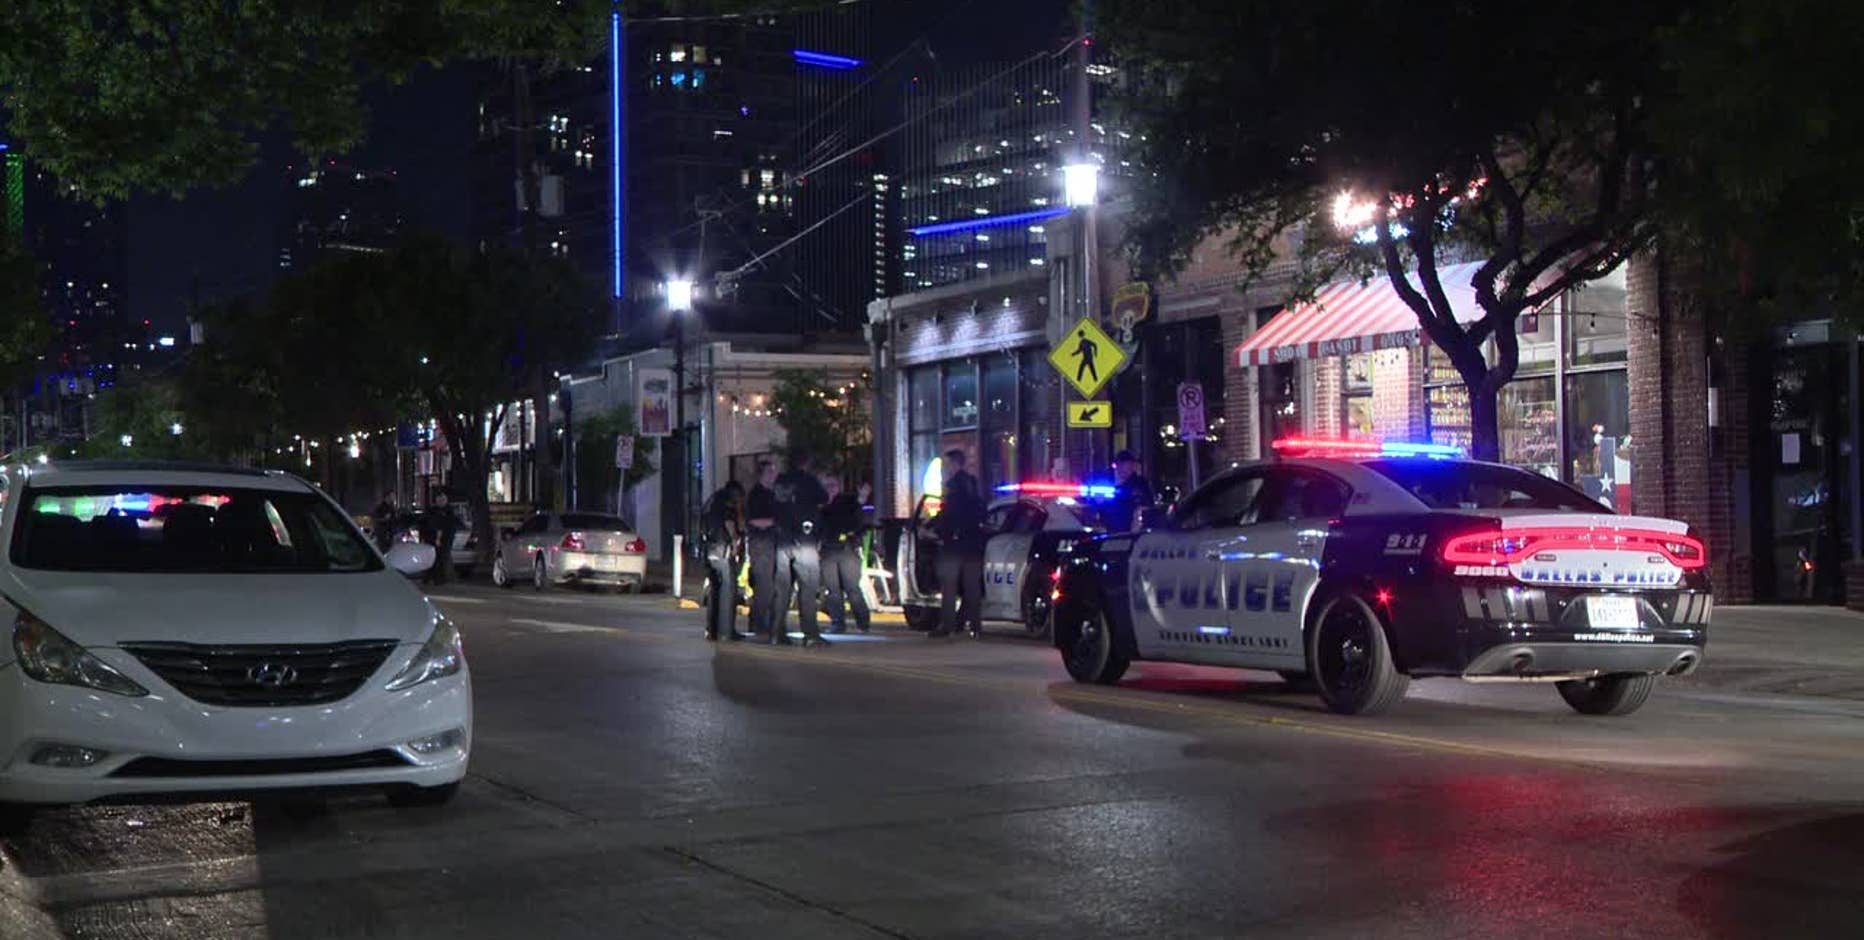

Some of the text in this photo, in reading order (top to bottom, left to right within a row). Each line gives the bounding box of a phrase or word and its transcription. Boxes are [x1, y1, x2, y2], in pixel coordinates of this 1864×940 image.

[1521, 567, 1675, 584] DALLAS POLICE
[1155, 570, 1295, 612] POLICE
